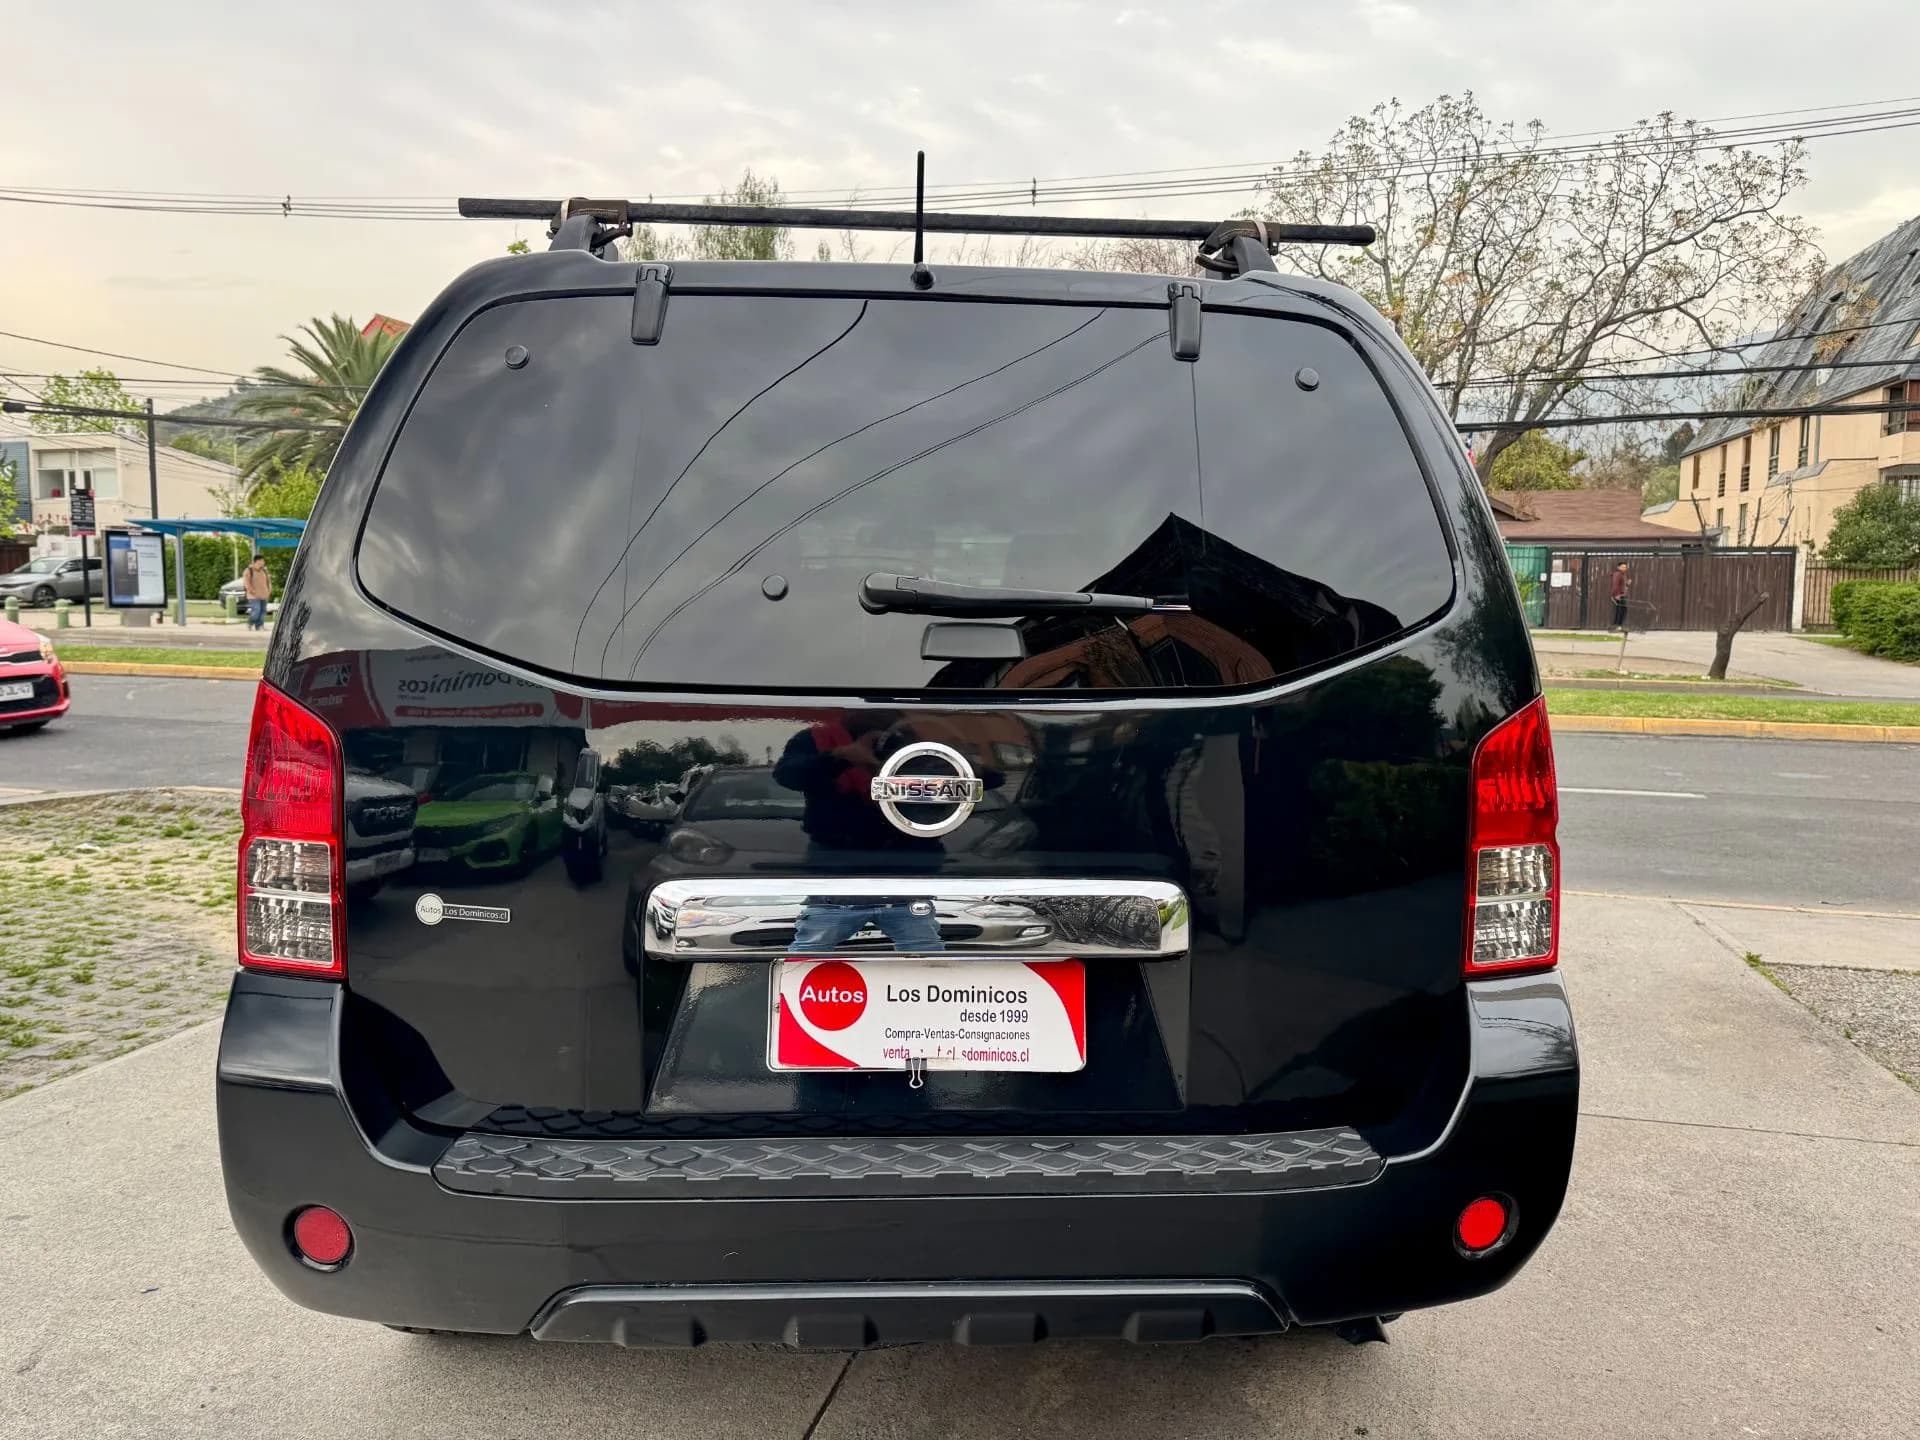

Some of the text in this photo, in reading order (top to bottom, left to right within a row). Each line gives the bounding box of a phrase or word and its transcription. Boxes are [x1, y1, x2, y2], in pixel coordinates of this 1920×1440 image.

[882, 782, 971, 797] NISSAN
[420, 905, 507, 920] Autos Los Dominicos.cl
[801, 985, 864, 1004] Autos
[887, 984, 1028, 1004] Los Dominicos
[960, 1008, 1029, 1023] desde 1999
